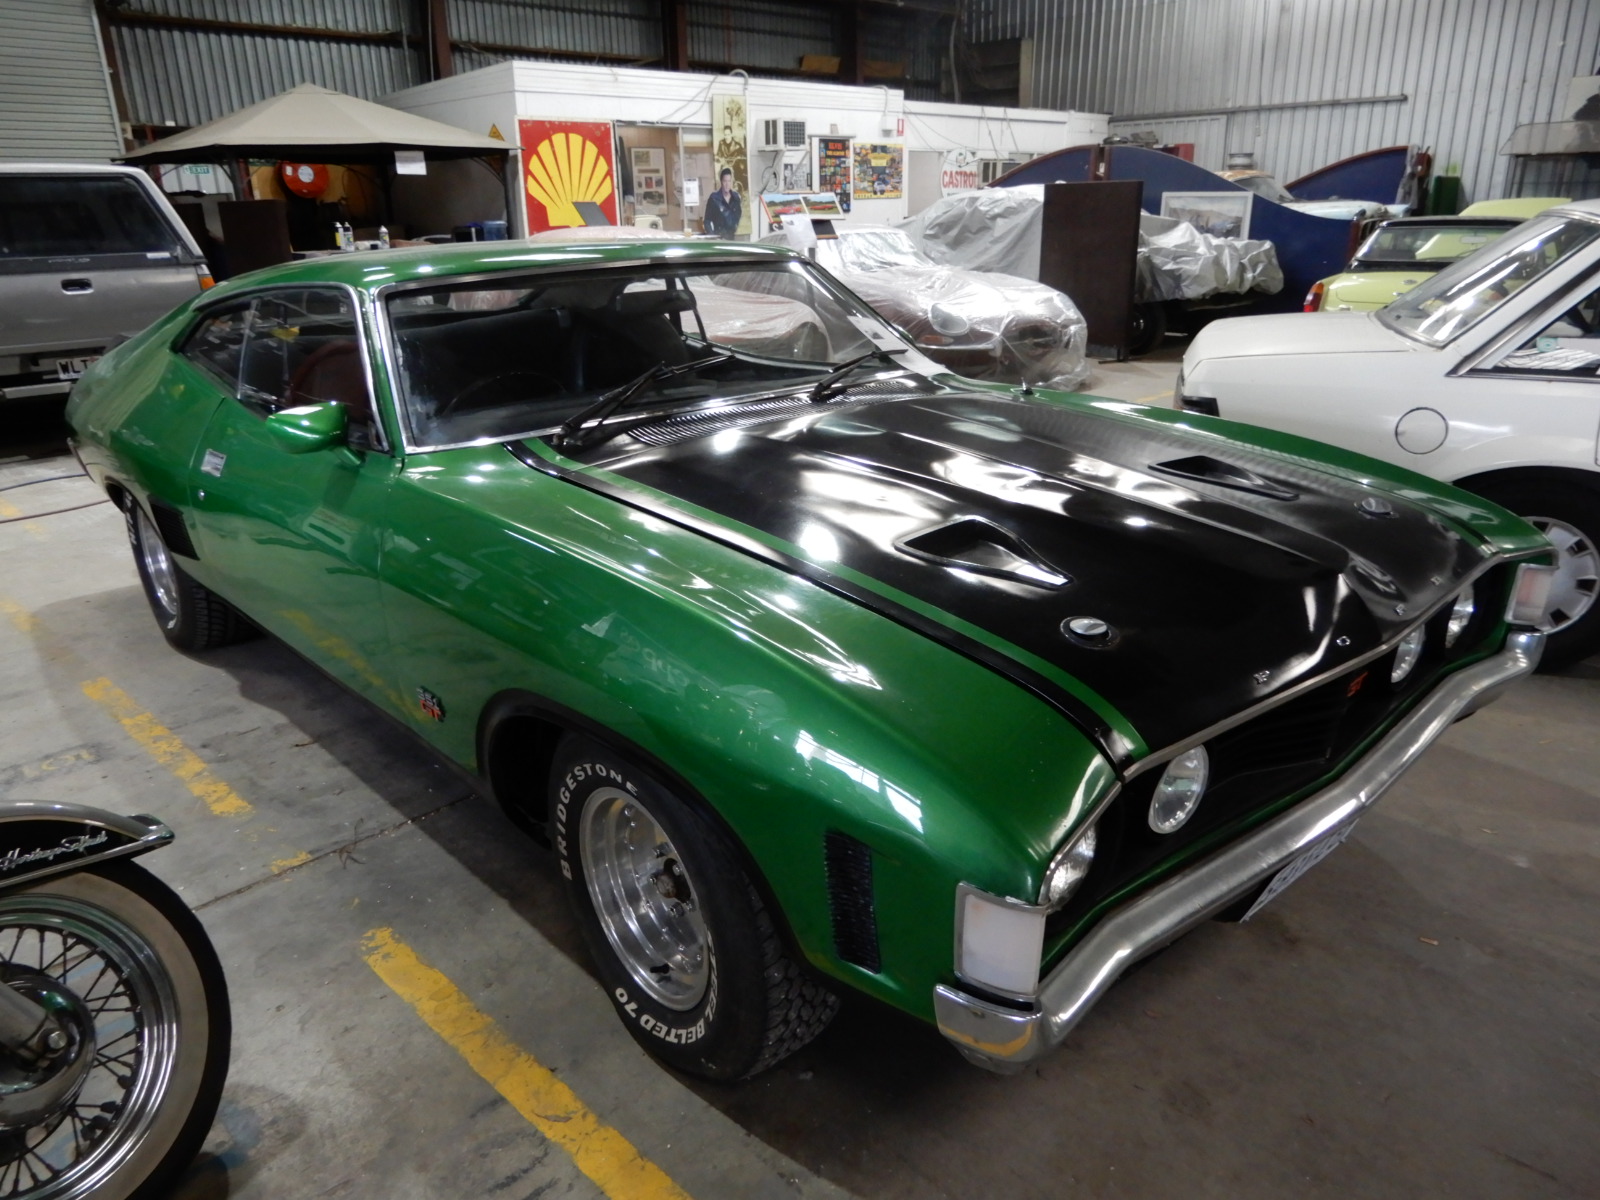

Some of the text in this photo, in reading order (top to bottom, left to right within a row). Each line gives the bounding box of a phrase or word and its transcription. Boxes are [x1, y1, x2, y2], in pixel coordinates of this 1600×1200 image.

[556, 763, 638, 880] BRIDGESTONE
[615, 987, 638, 1018] 70
[639, 1014, 706, 1044] BELTED
